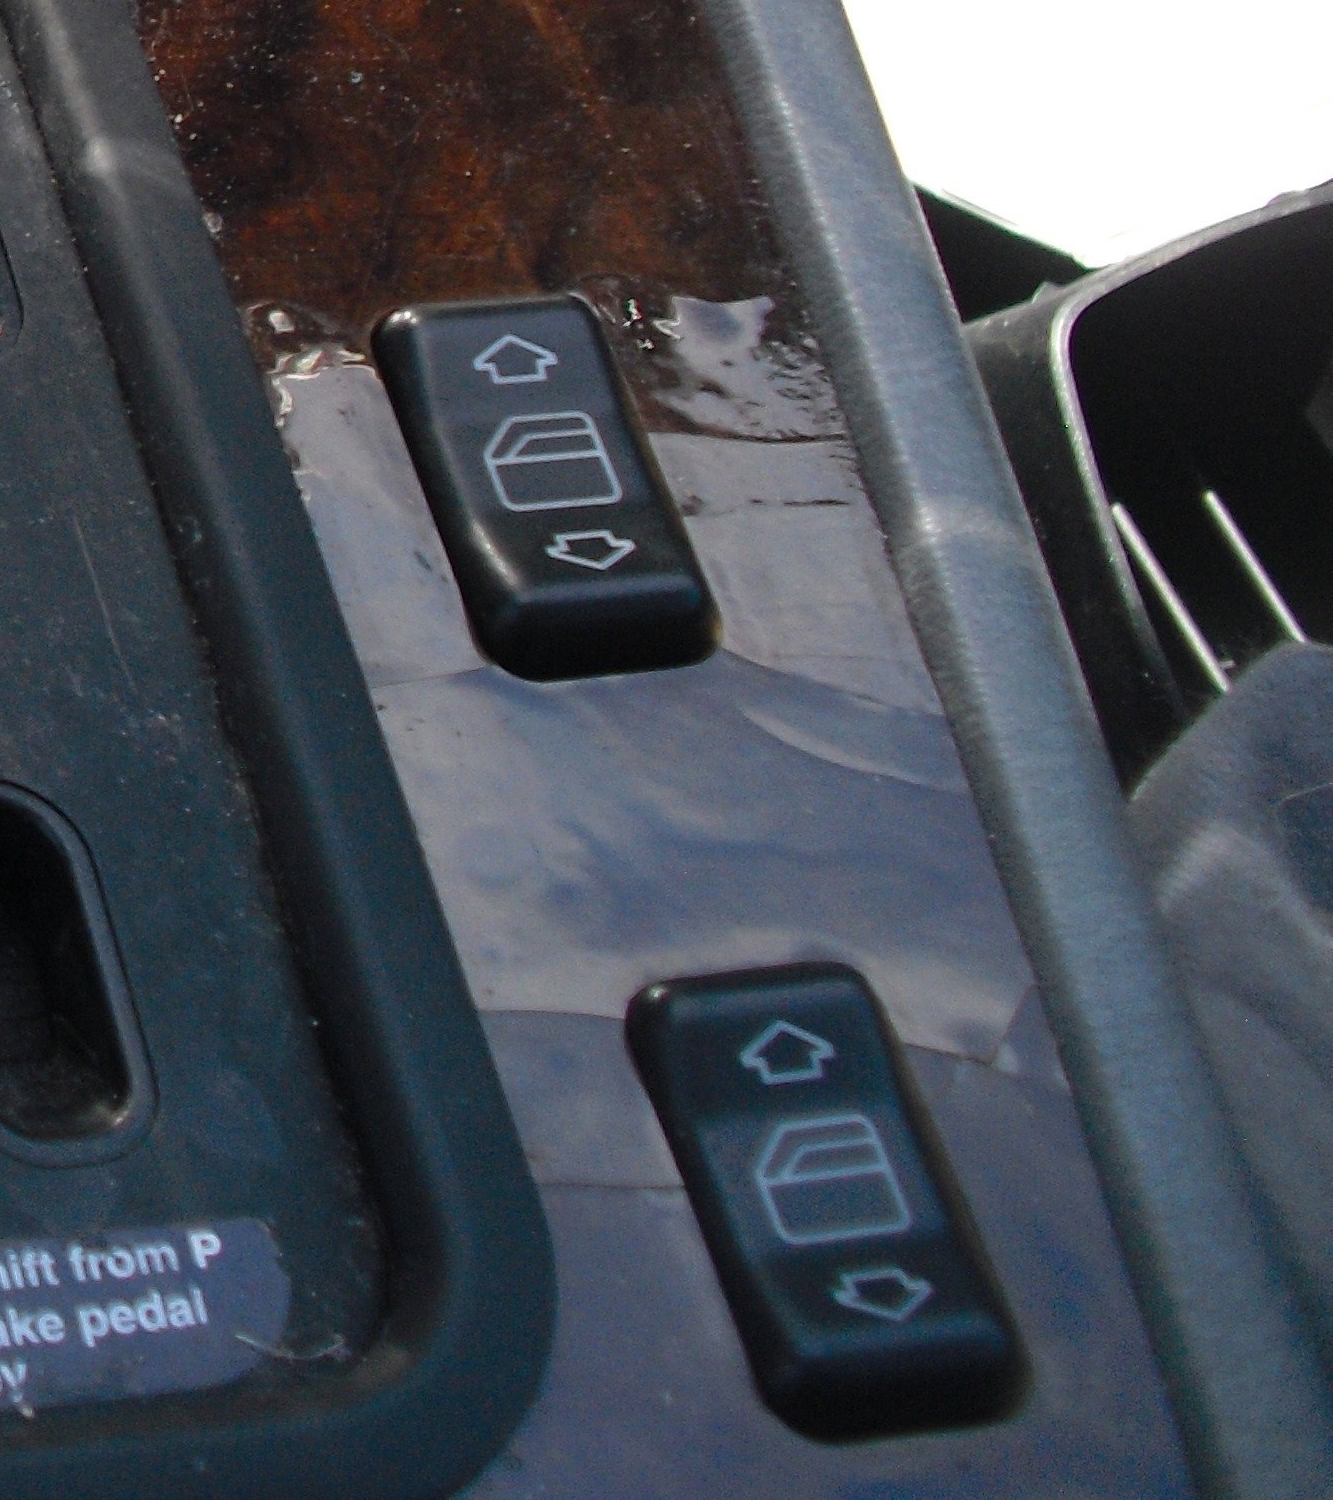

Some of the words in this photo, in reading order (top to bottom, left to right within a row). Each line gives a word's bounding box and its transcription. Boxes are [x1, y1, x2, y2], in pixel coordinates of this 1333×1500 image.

[68, 1242, 180, 1283] from
[186, 1228, 221, 1270] P
[76, 1285, 209, 1347] pedal
